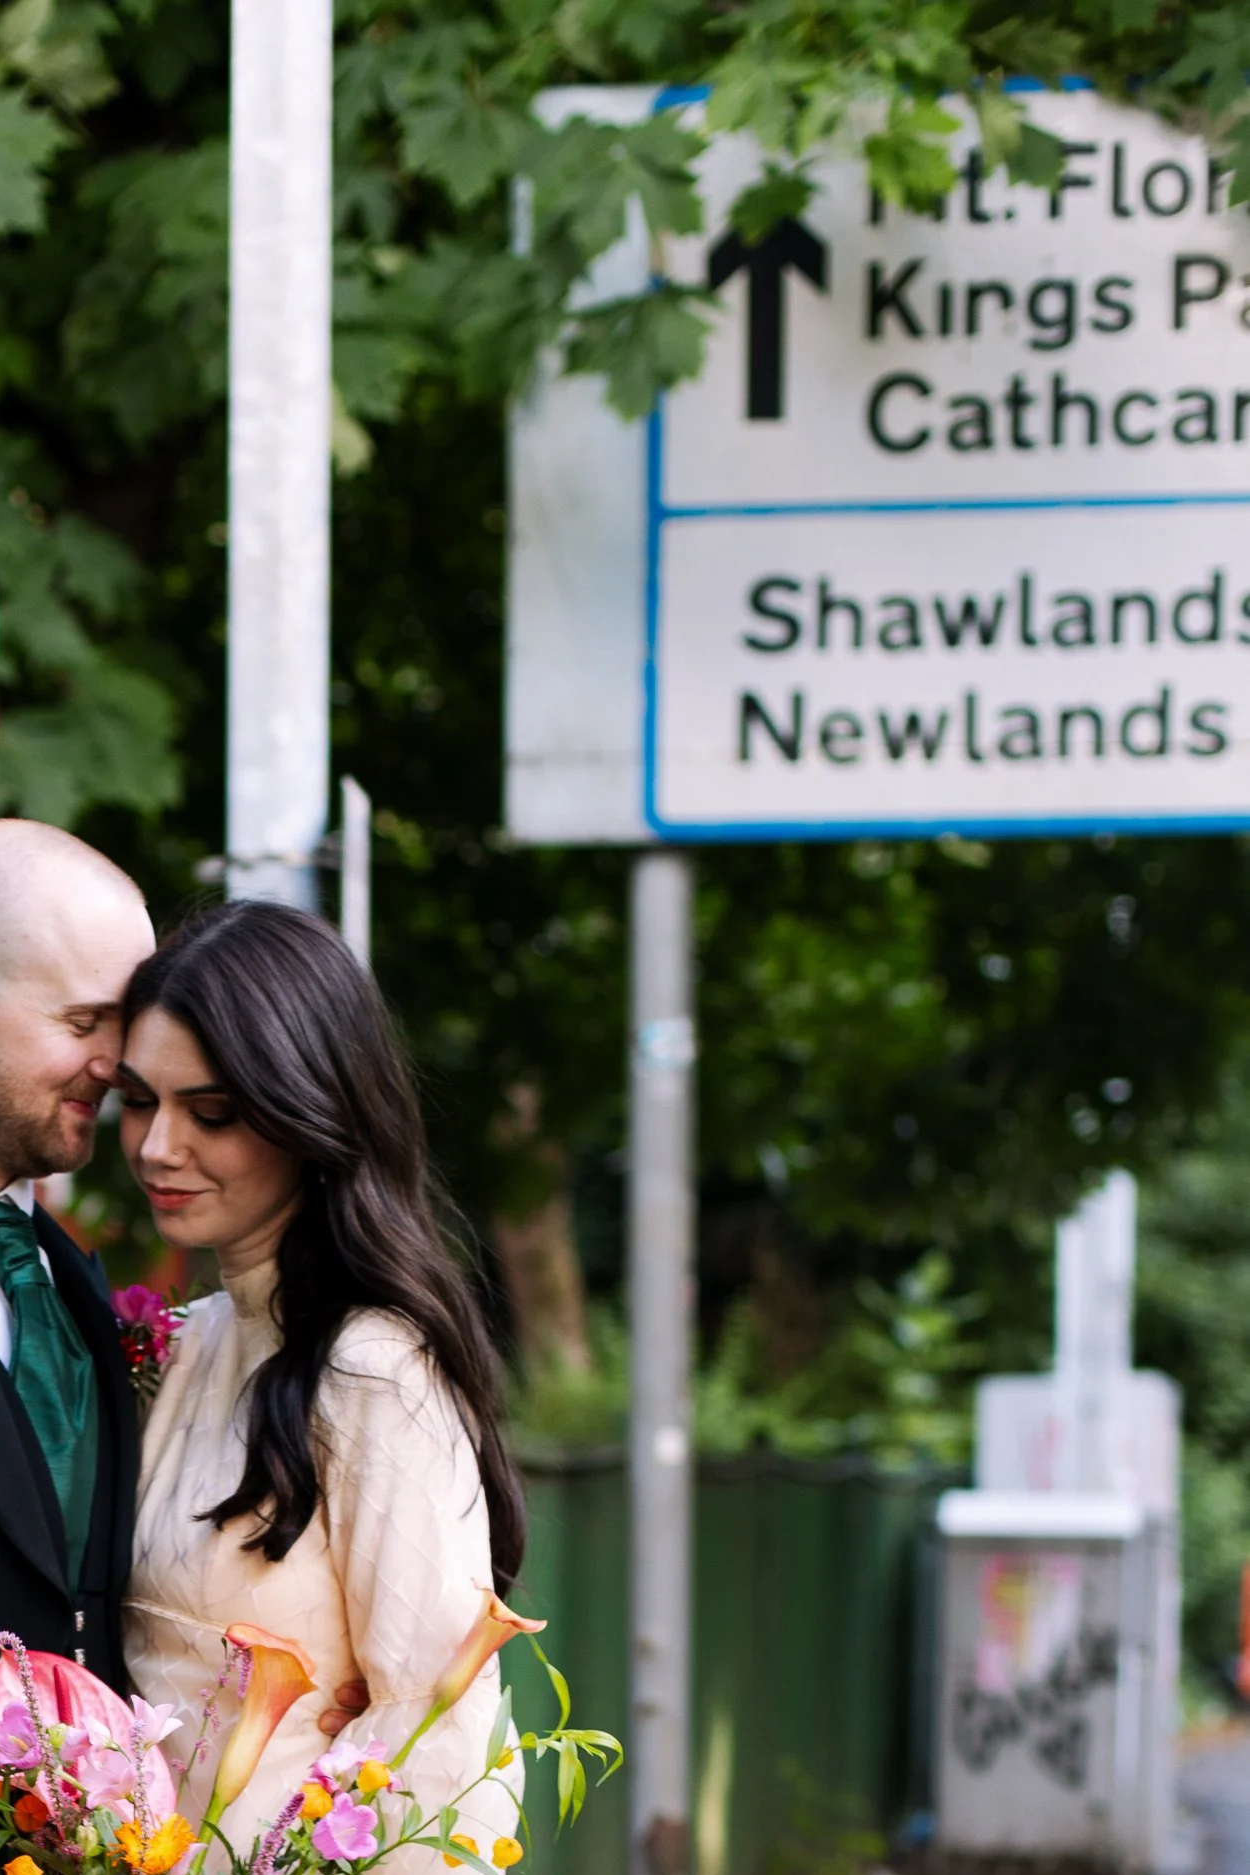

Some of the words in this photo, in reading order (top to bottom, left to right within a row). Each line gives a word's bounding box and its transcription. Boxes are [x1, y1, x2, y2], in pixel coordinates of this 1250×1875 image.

[1048, 140, 1250, 219] Flor
[865, 256, 1135, 352] Kings
[1172, 253, 1250, 331] P
[737, 684, 1230, 763] Newlands
